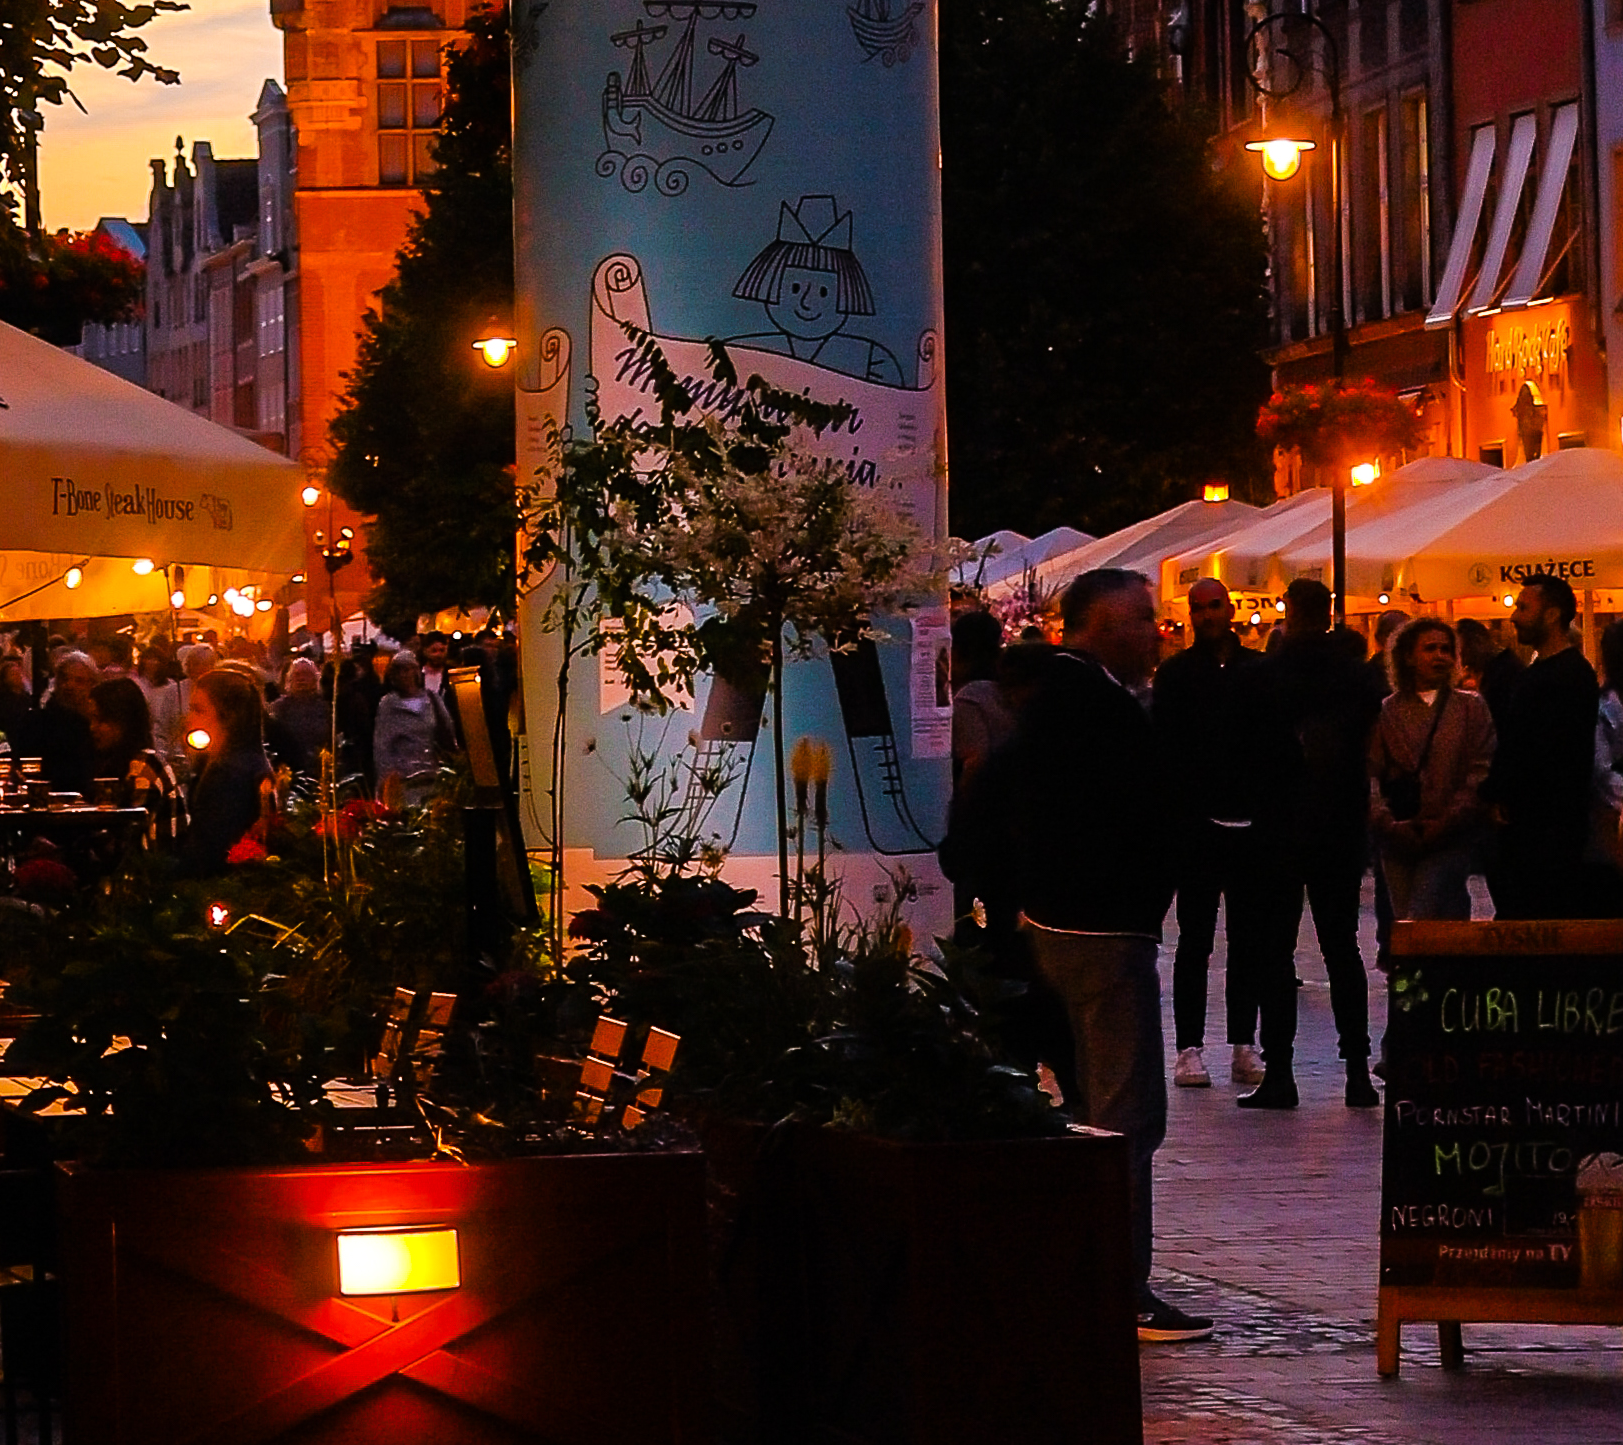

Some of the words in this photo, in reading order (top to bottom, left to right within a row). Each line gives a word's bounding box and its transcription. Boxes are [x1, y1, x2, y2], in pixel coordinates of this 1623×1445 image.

[51, 477, 101, 516] T-Bone
[146, 487, 194, 525] House
[1441, 987, 1519, 1033] CUBA
[1537, 987, 1623, 1036] LIBRE
[1526, 1096, 1619, 1127] MARTINI
[1434, 1141, 1573, 1196] MOJITO
[1391, 1204, 1493, 1231] NEGRONI
[1525, 1248, 1544, 1260] na
[1546, 1243, 1573, 1262] TY
